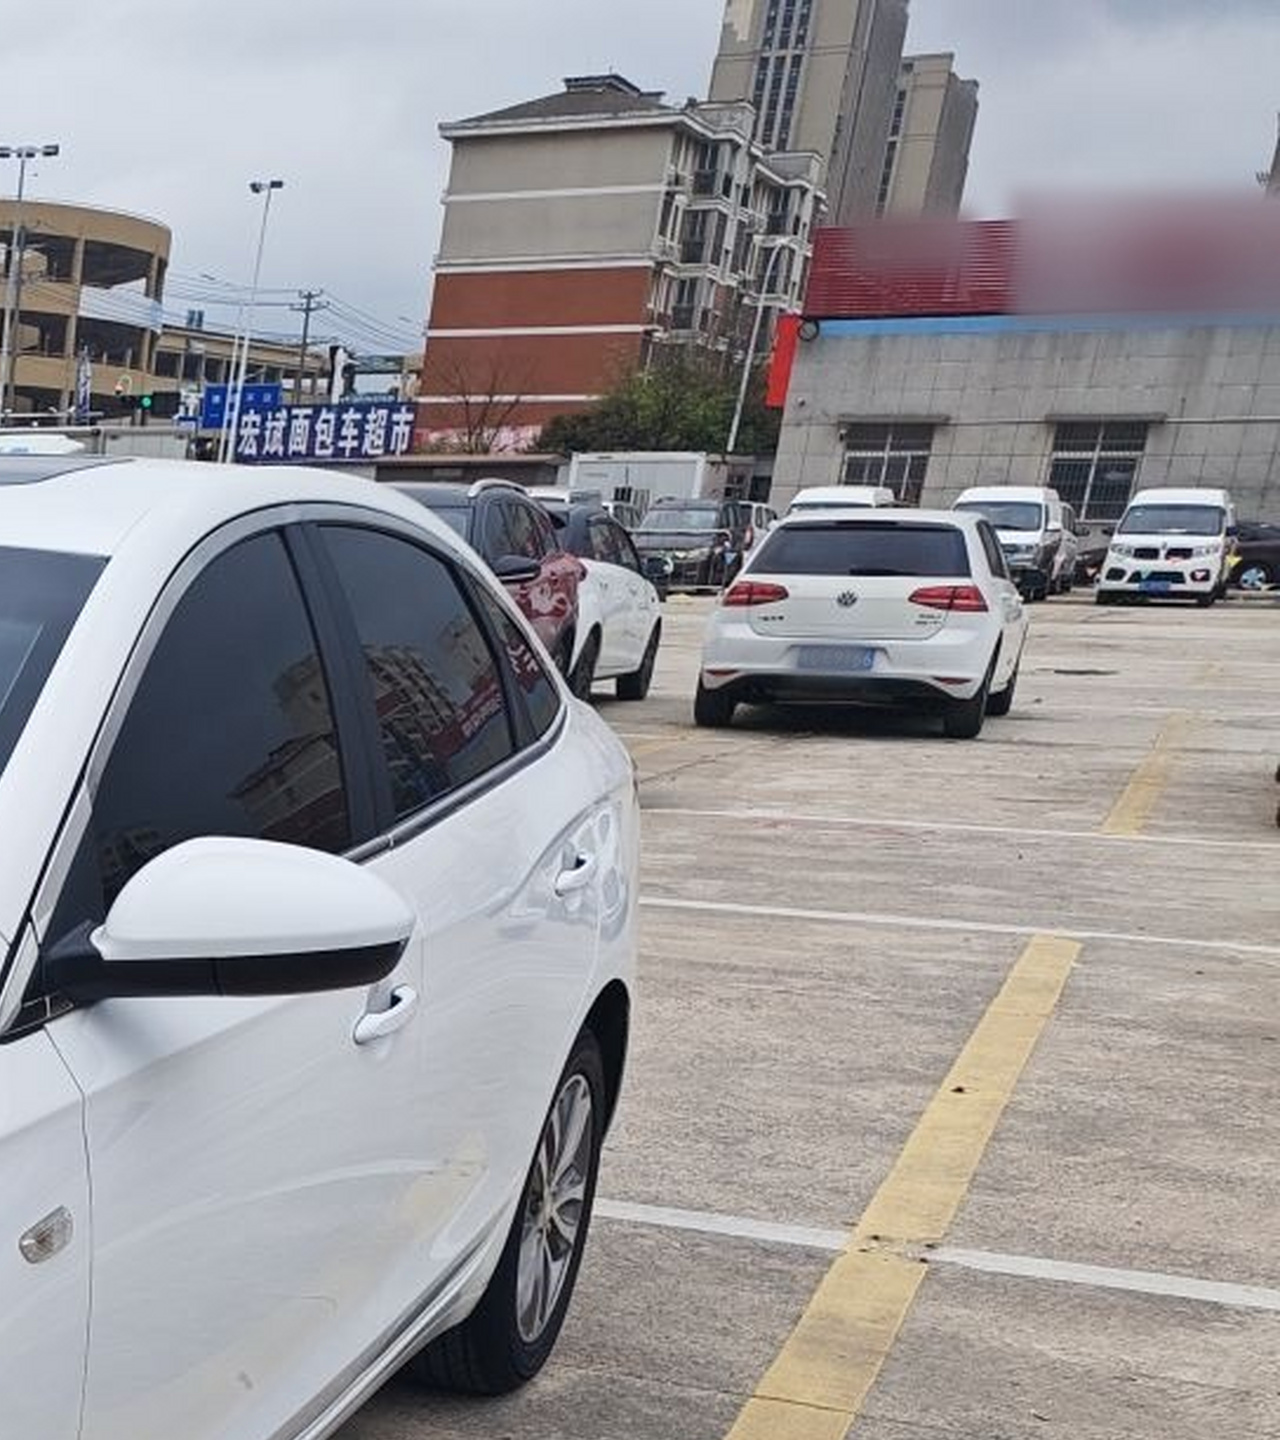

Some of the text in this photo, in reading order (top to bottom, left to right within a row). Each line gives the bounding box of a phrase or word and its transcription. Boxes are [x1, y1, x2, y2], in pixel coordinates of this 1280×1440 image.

[237, 406, 415, 458] 宏斌面包车超市
